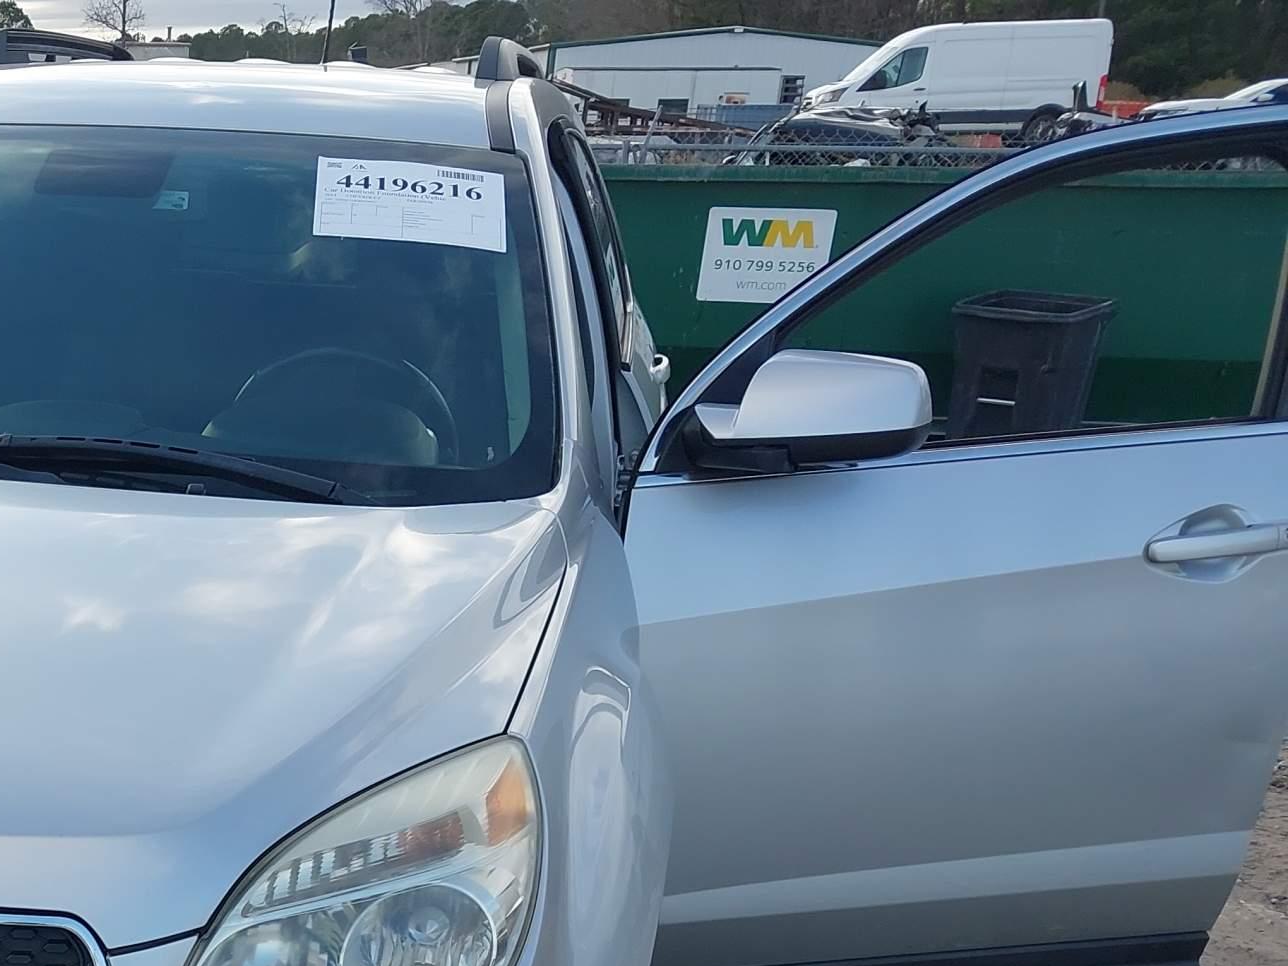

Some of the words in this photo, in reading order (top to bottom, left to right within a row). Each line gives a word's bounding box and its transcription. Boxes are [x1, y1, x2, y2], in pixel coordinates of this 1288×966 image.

[336, 174, 483, 201] 44196216
[722, 218, 815, 249] WM
[714, 258, 742, 271] 910
[746, 260, 774, 272] 799
[778, 260, 815, 273] 5256
[736, 281, 787, 291] wm.com
